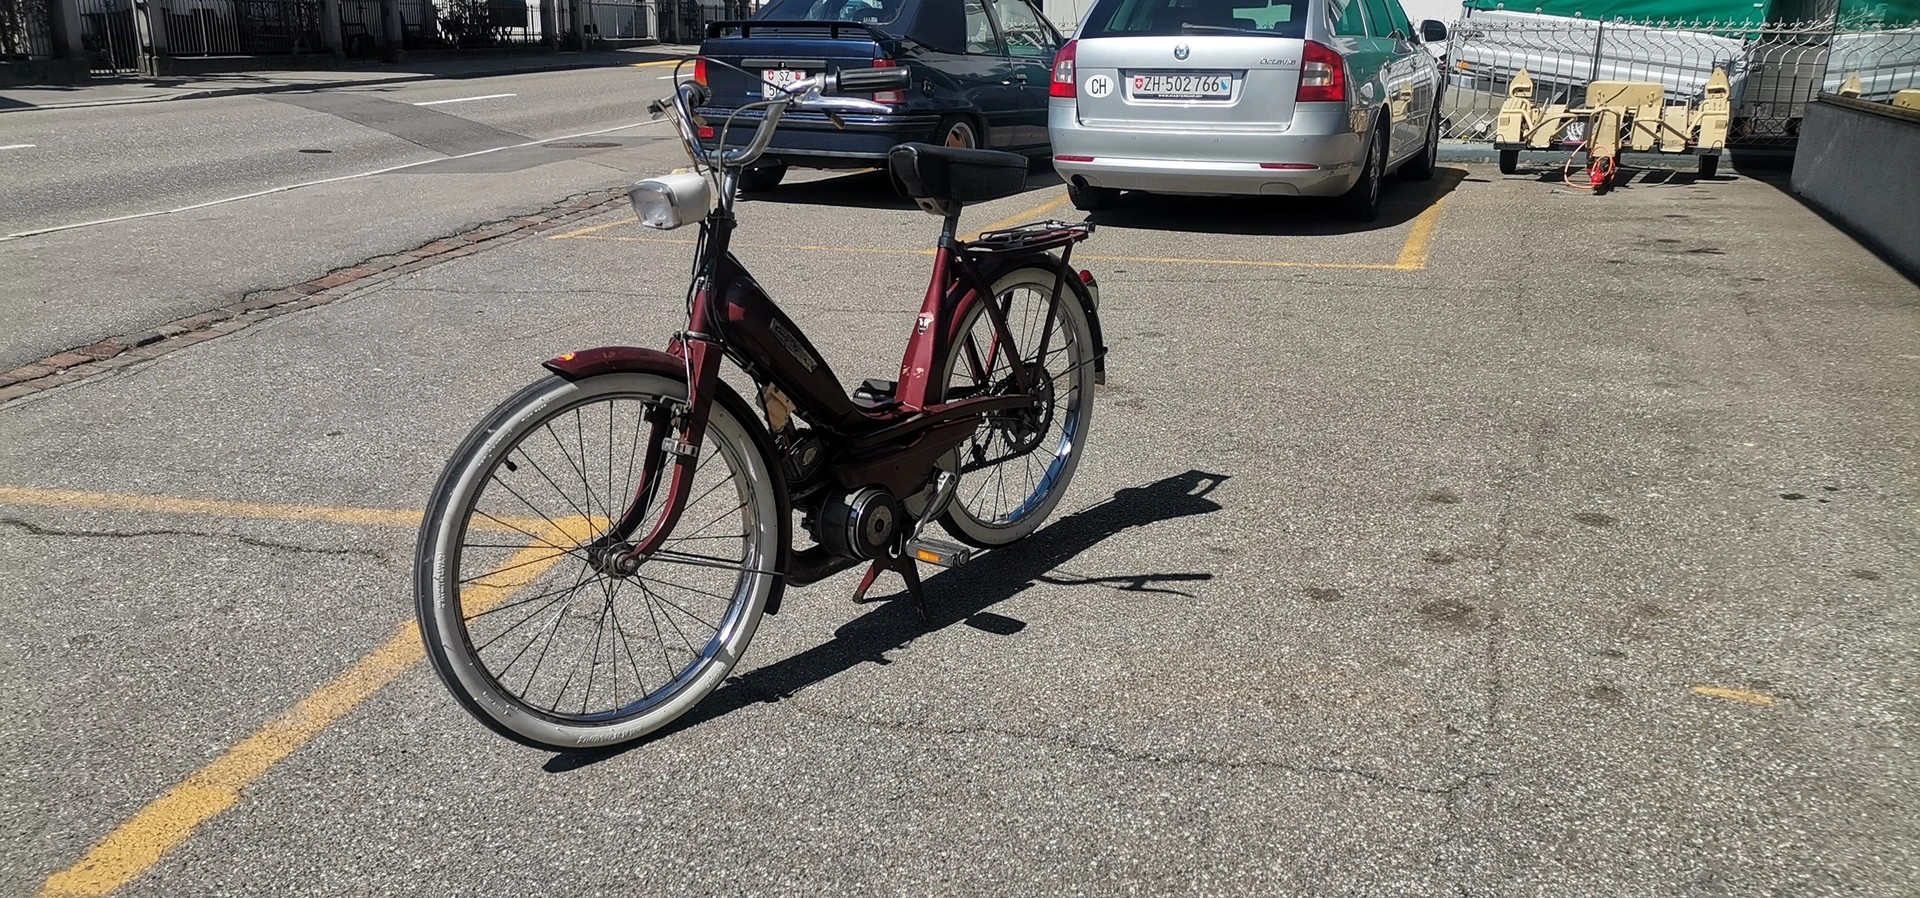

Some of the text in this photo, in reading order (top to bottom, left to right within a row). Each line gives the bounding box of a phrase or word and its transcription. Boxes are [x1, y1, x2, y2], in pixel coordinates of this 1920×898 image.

[1260, 58, 1296, 66] Octavia
[779, 71, 790, 82] SZ
[1091, 78, 1107, 95] CH
